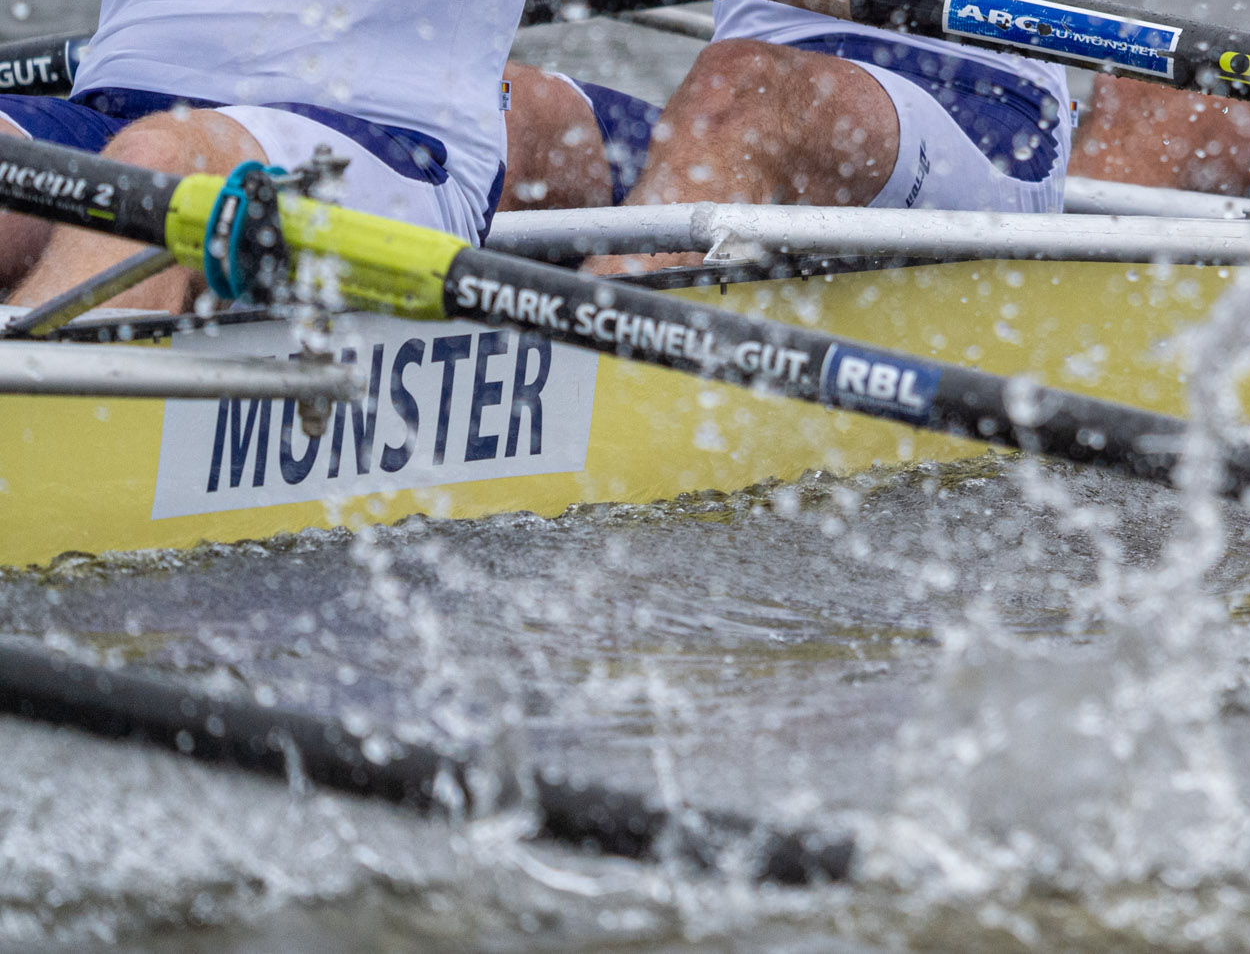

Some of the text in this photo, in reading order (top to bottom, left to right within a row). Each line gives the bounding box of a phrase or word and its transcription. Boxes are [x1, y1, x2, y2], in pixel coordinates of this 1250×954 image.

[0, 55, 59, 88] GUT.
[91, 183, 115, 207] 2
[457, 275, 811, 385] STARK. SCHNELL GUT.
[836, 355, 925, 406] RBL
